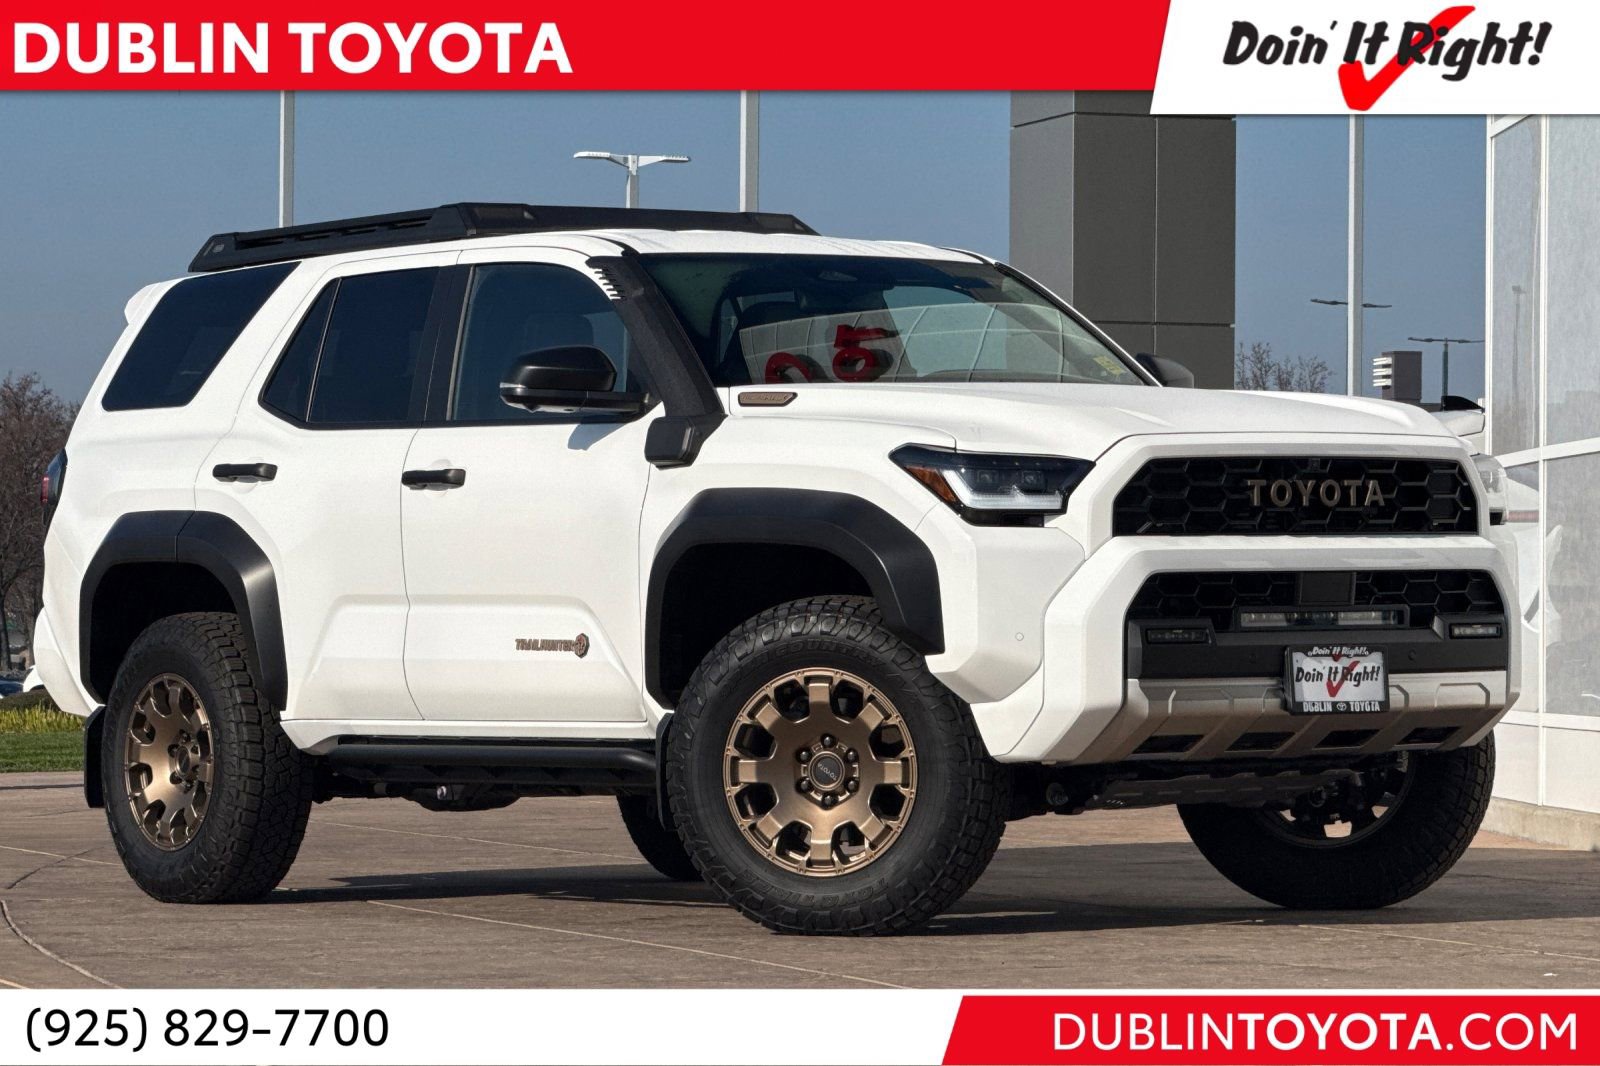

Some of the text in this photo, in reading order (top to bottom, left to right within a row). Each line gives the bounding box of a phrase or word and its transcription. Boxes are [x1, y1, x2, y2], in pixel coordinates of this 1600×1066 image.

[1247, 479, 1386, 507] TOYOTA
[1295, 665, 1381, 687] Doin' It Right!
[1302, 701, 1381, 712] DUBLIN TOYOTA
